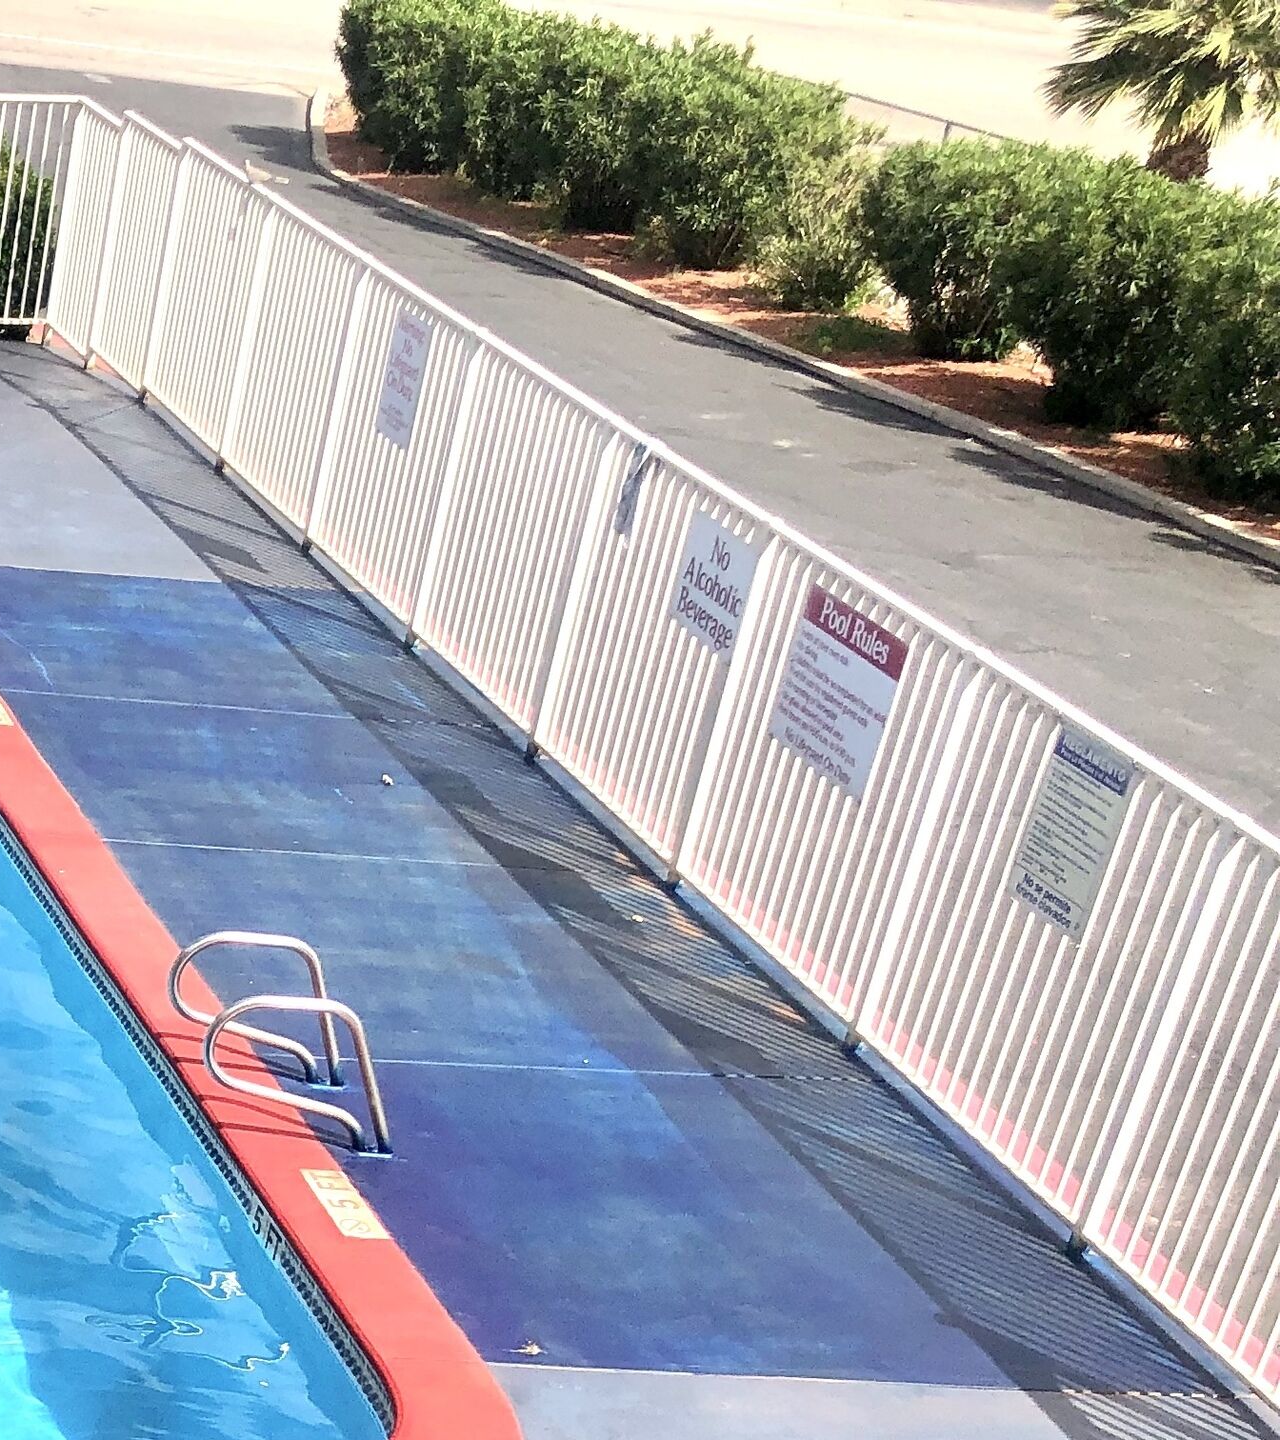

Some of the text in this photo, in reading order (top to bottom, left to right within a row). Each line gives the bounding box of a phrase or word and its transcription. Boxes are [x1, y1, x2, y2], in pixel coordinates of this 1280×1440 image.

[709, 534, 731, 571] No
[683, 556, 743, 618] Alcoholic
[676, 585, 733, 651] Beverage
[819, 596, 853, 639] Pool
[849, 617, 890, 665] Rules
[251, 1204, 283, 1261] 5 FT
[326, 1198, 362, 1210] 5
